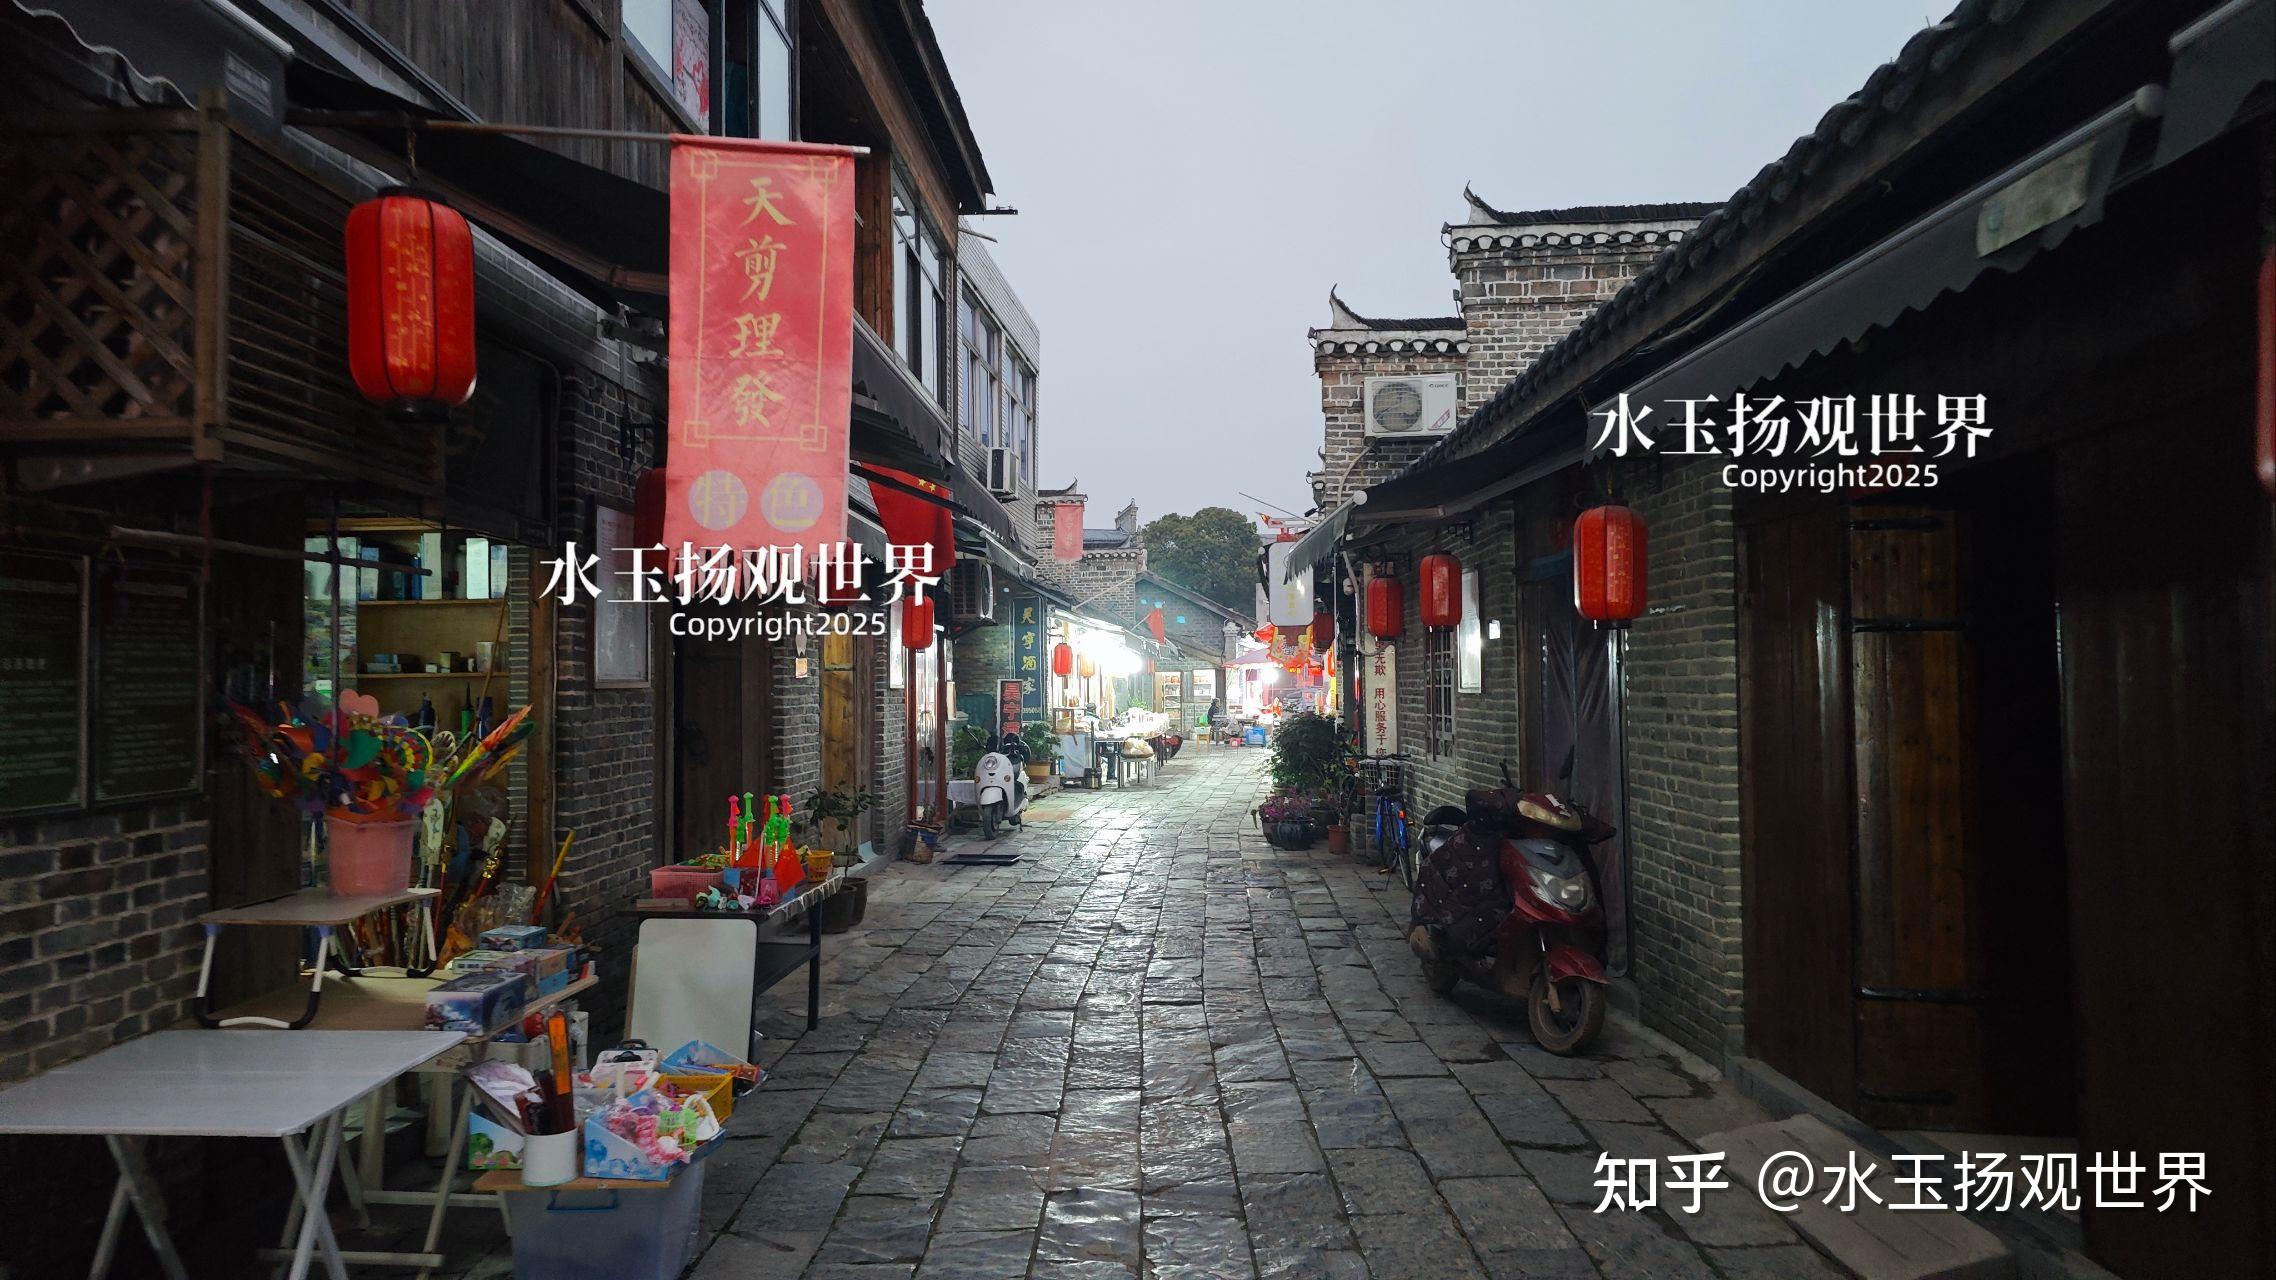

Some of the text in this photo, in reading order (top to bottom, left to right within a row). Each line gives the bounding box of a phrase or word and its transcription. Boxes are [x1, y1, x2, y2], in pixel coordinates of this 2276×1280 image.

[728, 176, 798, 428] 天剪理發
[692, 470, 818, 529] 特色
